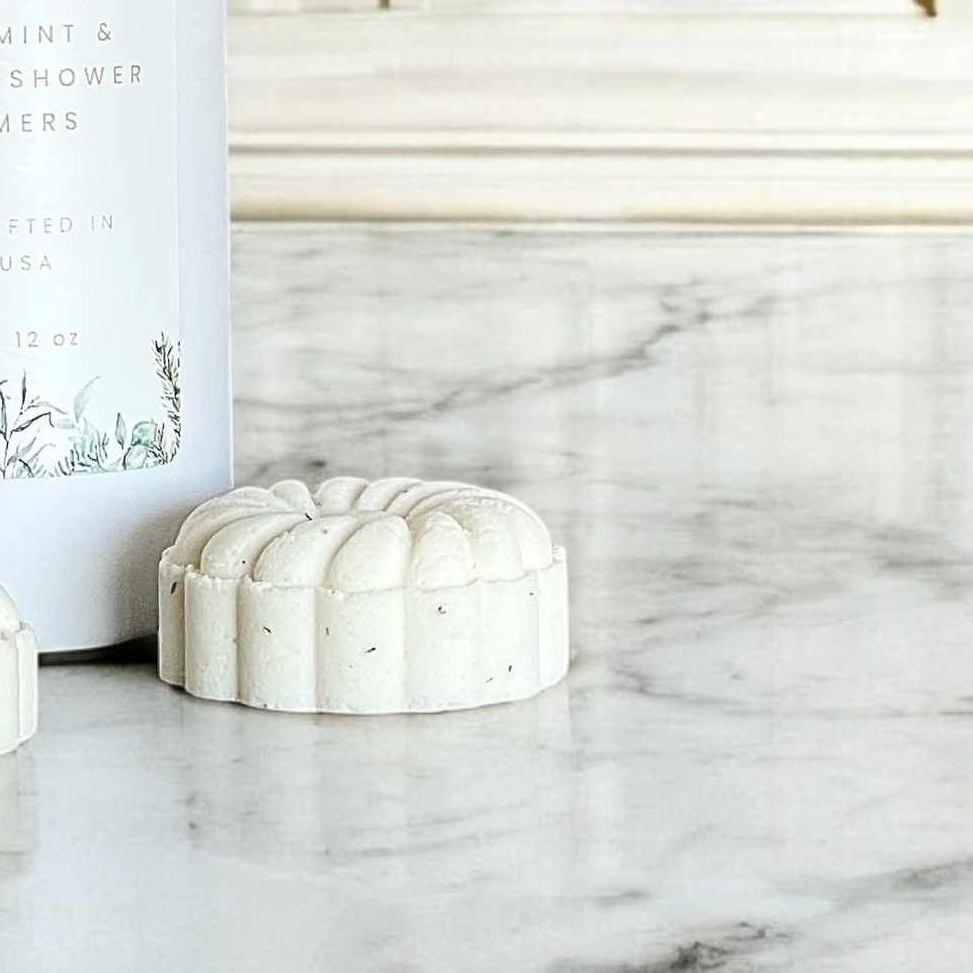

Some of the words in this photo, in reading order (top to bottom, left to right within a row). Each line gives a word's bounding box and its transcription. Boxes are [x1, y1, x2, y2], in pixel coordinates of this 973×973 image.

[97, 23, 112, 41] &
[10, 65, 142, 88] SHOWER
[91, 214, 114, 231] IN
[0, 255, 53, 272] USA
[15, 331, 39, 348] 12
[53, 332, 78, 348] oz
